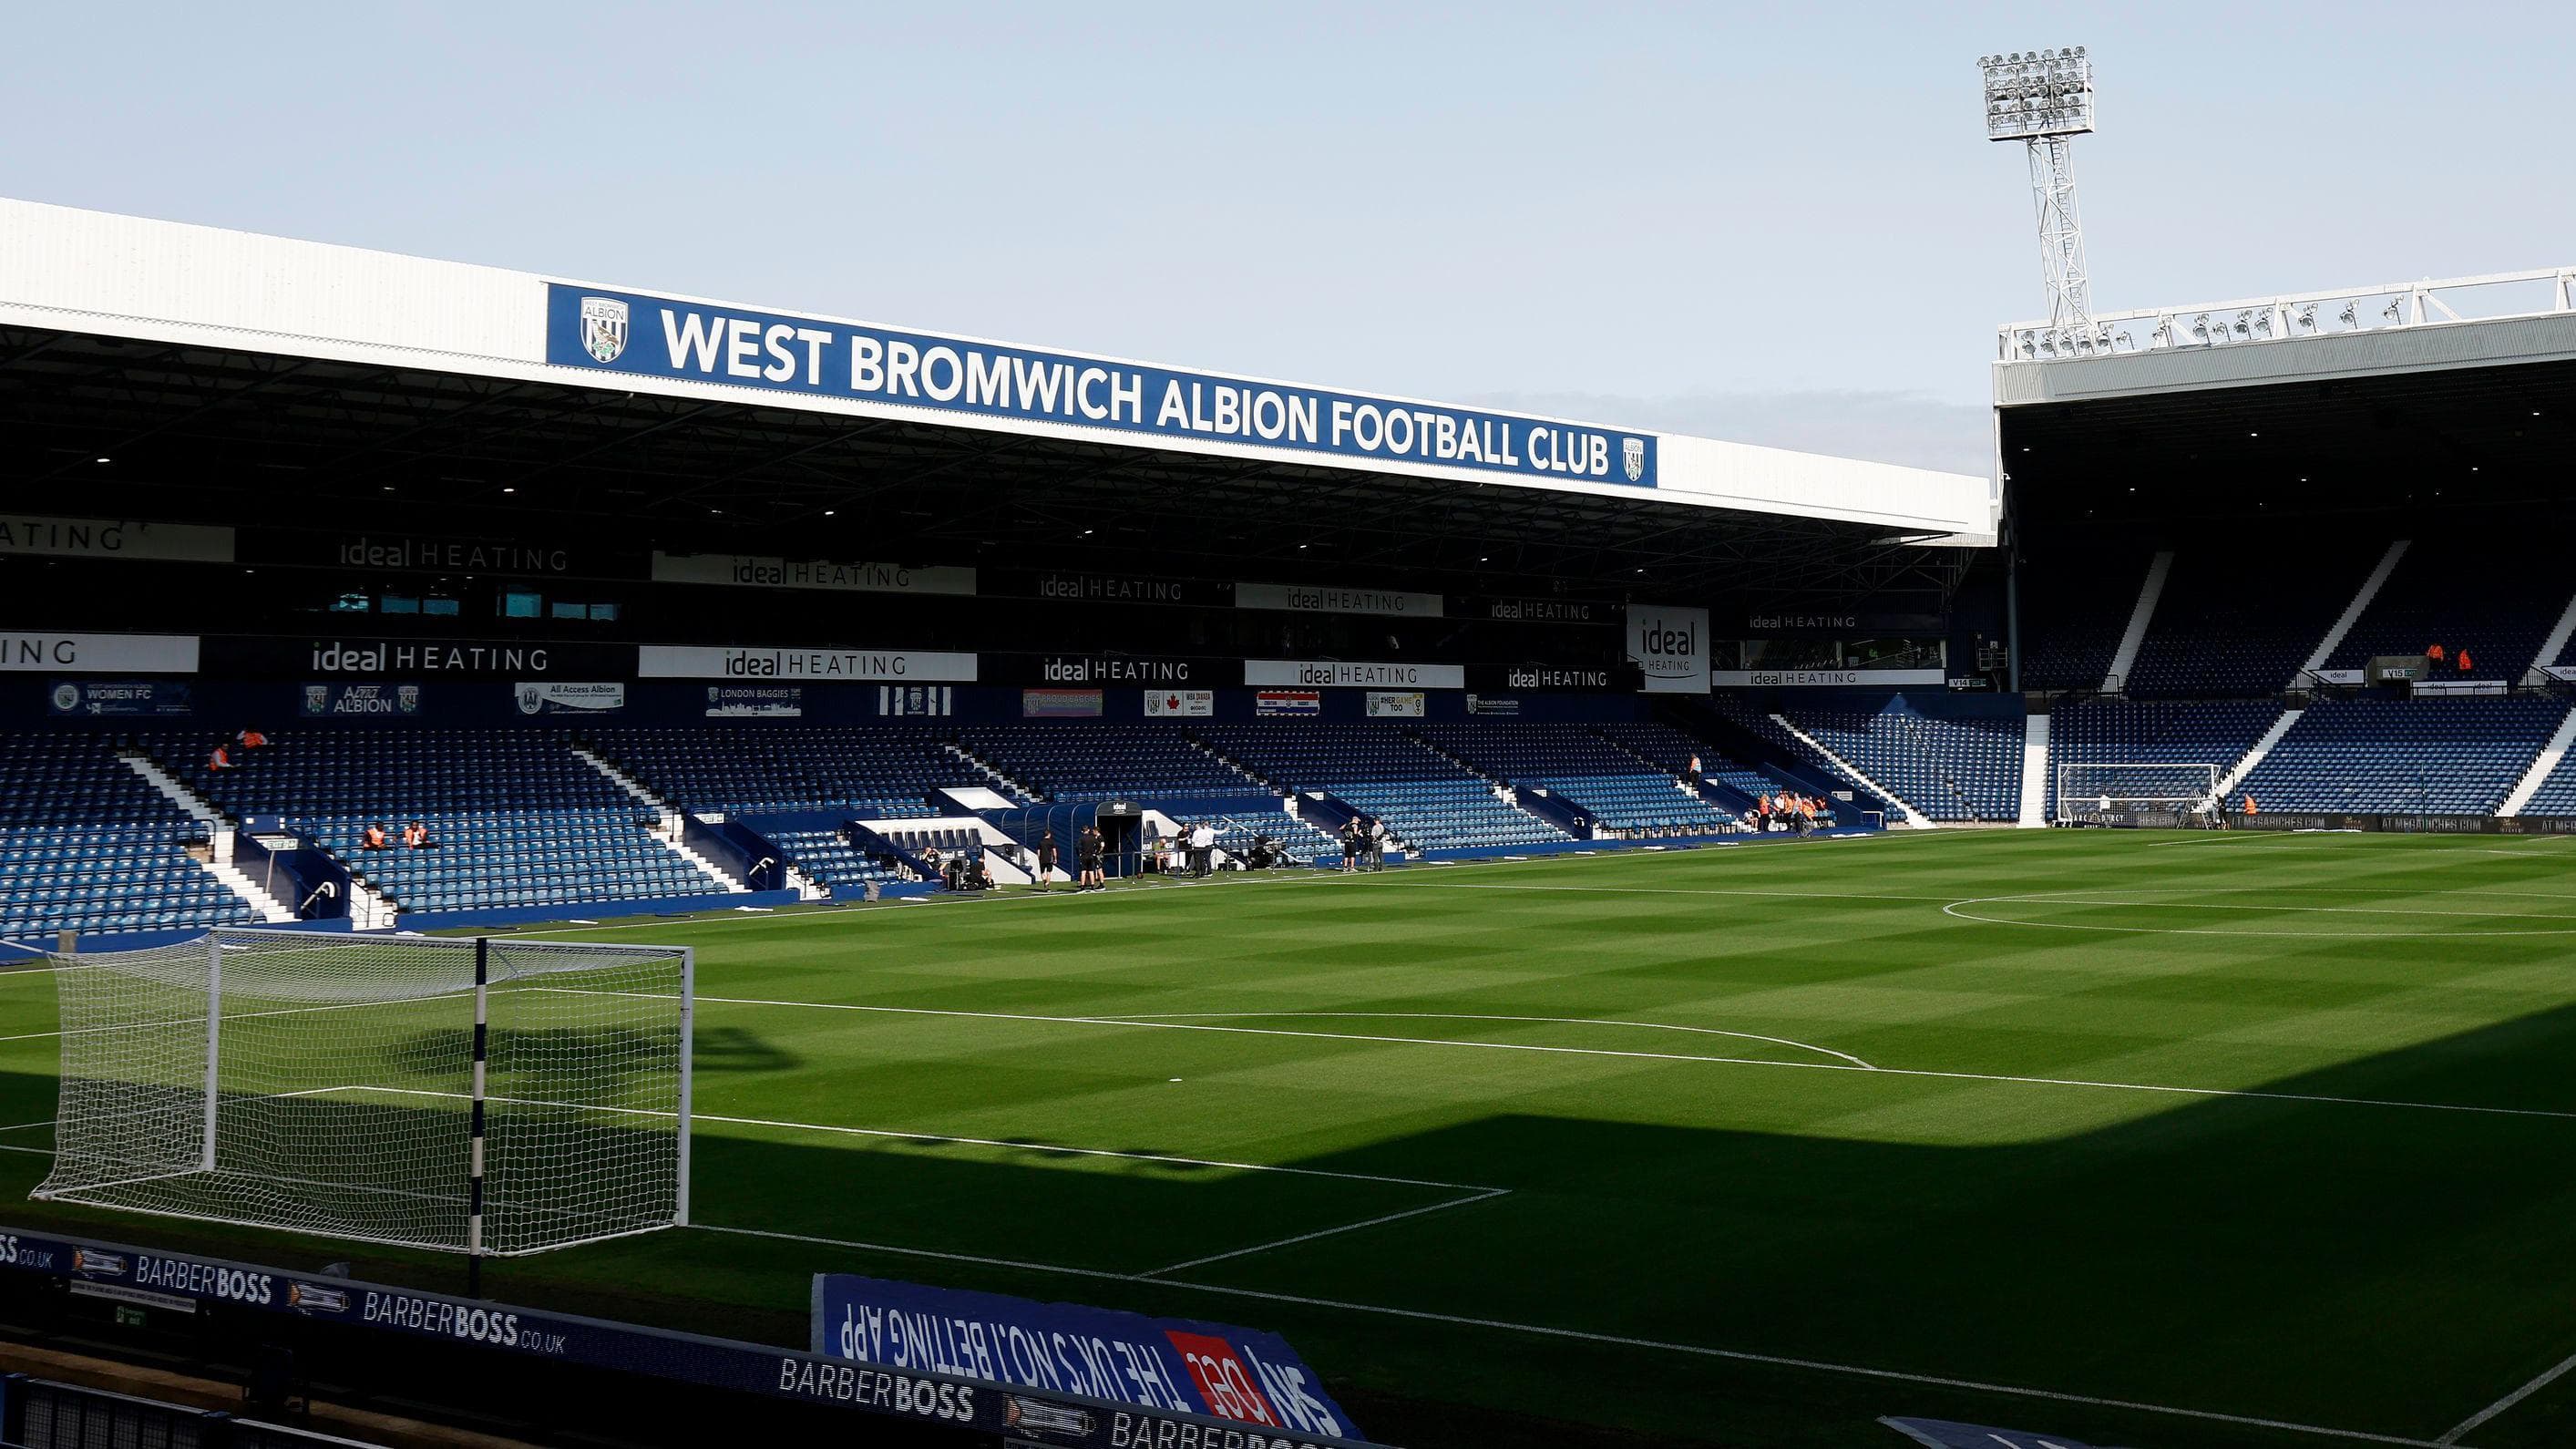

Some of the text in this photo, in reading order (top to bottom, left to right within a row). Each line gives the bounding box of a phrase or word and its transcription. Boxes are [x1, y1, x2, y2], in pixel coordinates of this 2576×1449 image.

[584, 306, 624, 320] ALBION
[660, 308, 1610, 476] WEST BROMWICH ALBION FOOTBALL CLUB
[0, 521, 121, 550] ATING
[339, 536, 567, 571] ideal HEATING
[733, 557, 910, 587] ideal HEATING
[1040, 574, 1181, 600] ideal HEATING
[1288, 588, 1404, 611] ideal HEATING
[1492, 599, 1590, 620] ideal HEATING
[1750, 616, 1856, 629] ideal HEATING
[1642, 619, 1695, 656] ideal
[1, 640, 76, 663] ING
[313, 641, 548, 672] ideal HEATING
[725, 650, 907, 676] ideal HEATING
[1043, 657, 1189, 682] ideal HEATING
[1300, 663, 1417, 683] ideal HEATING
[1648, 660, 1689, 671] HEATING
[2560, 667, 2576, 676] idea
[1508, 668, 1607, 688] ideal HEATING
[1750, 672, 1857, 685] ideal HEATING
[2330, 671, 2347, 679] ideal
[87, 689, 152, 700] WOMEN FC
[550, 684, 616, 694] All Access Albion
[720, 689, 754, 698] LONDON
[756, 689, 789, 698] BAGGIES
[334, 698, 393, 713] ALBION
[1391, 704, 1403, 712] TOO
[1113, 802, 1127, 810] ideal
[2242, 817, 2326, 828] MEGARICHES.COM
[2382, 818, 2481, 832] AT MEGARICHES.COM
[2541, 820, 2552, 832] AT
[136, 1255, 272, 1305] BARBERBOSS
[839, 1302, 883, 1365] APP
[887, 1308, 996, 1382] BETTING
[989, 1321, 1060, 1393] NO.1
[1054, 1330, 1131, 1403] UK'S
[1112, 1341, 1194, 1413] THE
[779, 1357, 976, 1423] BARBERBOSS
